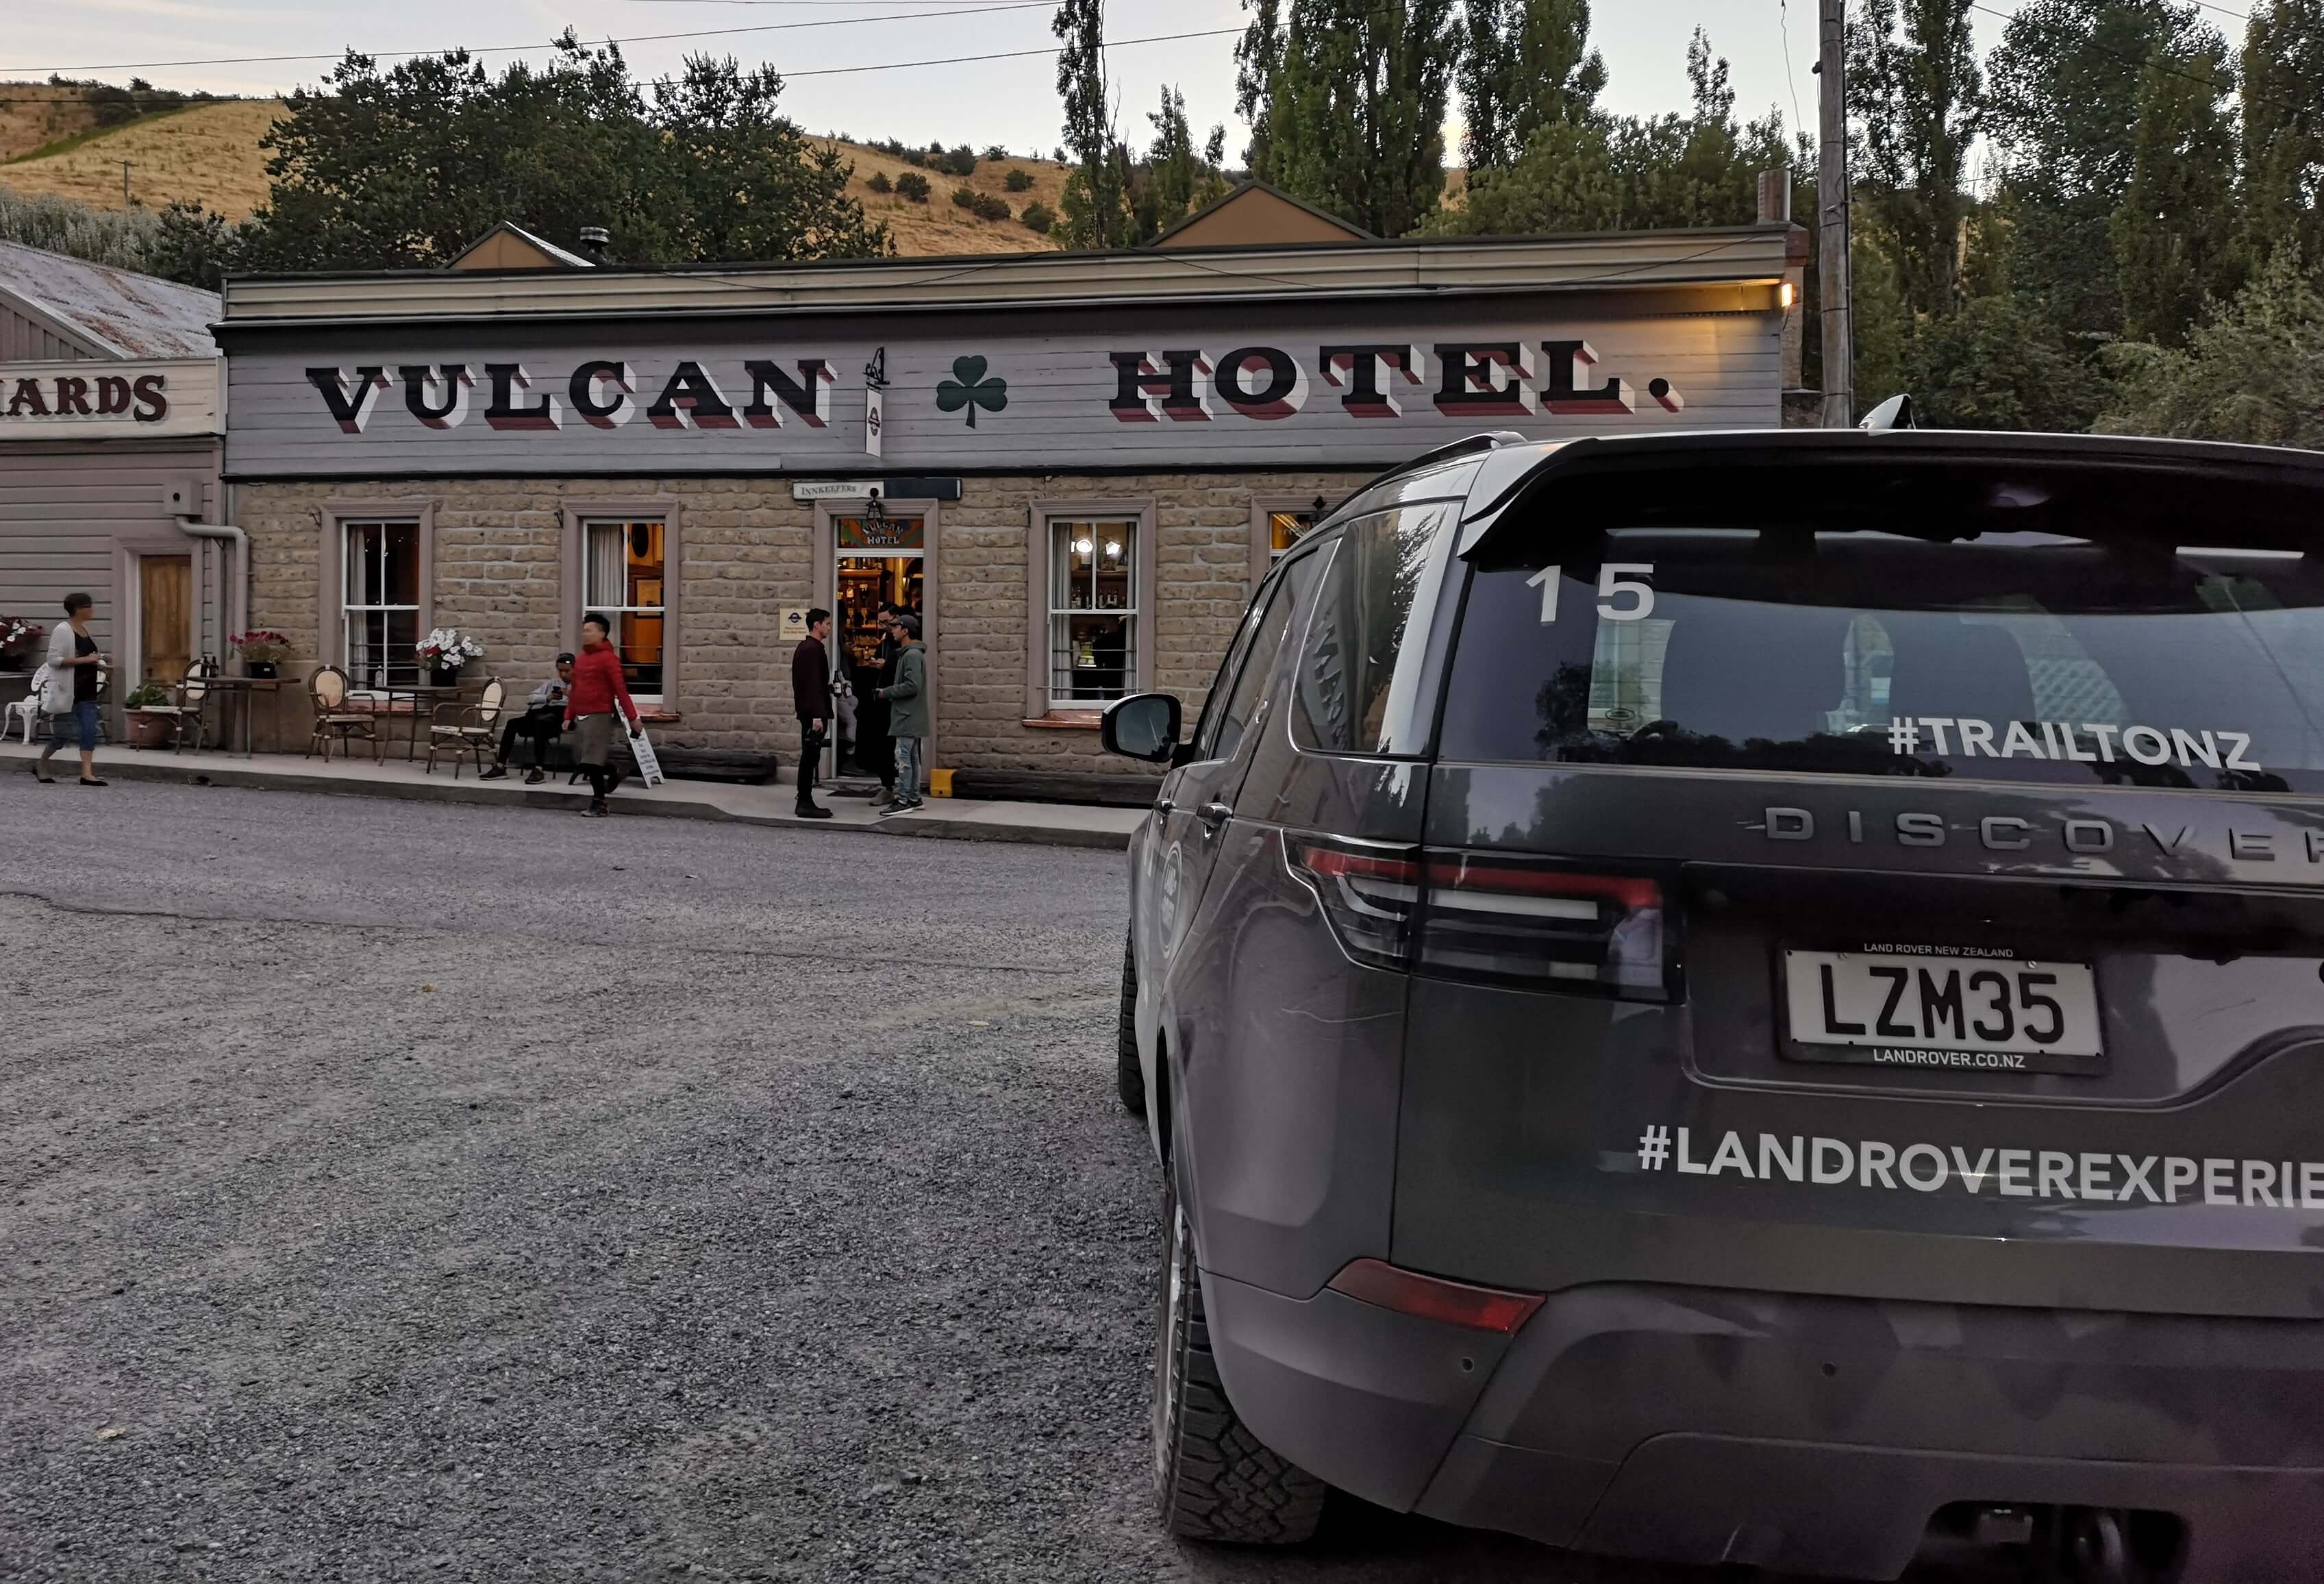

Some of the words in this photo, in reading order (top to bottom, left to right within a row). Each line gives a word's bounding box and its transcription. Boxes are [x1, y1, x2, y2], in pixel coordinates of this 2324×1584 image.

[0, 375, 167, 421] ARDS
[305, 360, 838, 434] VULCAN
[801, 485, 856, 495] INNKEEPERS
[862, 519, 904, 536] VULCAN
[866, 536, 899, 545] HOTEL
[1887, 716, 2261, 772] #TRAILTONZ
[1864, 942, 1893, 953] LAND
[1895, 943, 1932, 955] ROVER
[1934, 945, 1960, 956] NEW
[1962, 947, 2014, 958] ZEALAND
[1820, 963, 2064, 1044] LZM35
[1873, 1048, 2026, 1069] LANDROVER.CO.NZ
[1638, 1124, 2324, 1209] #LANDROVEREXPERIE
